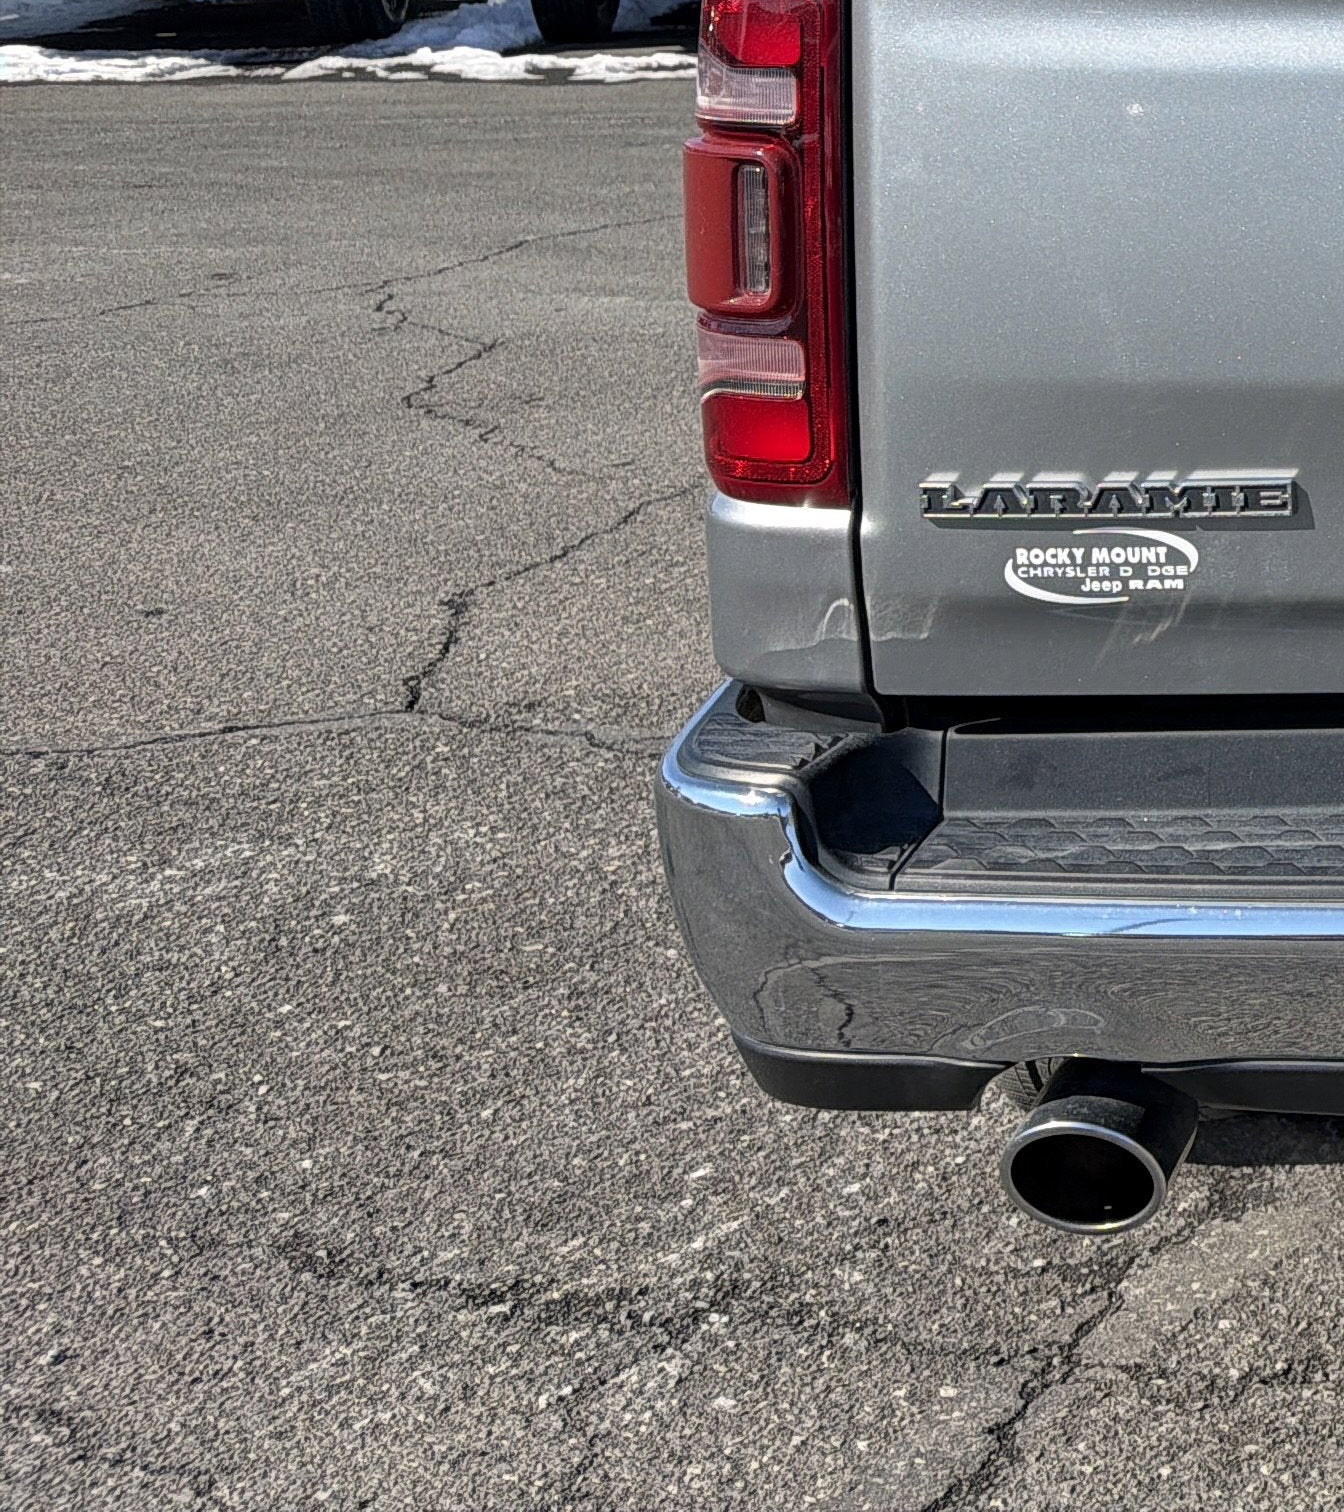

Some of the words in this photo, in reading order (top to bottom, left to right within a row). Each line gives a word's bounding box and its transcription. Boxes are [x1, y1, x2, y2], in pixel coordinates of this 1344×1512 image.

[918, 472, 1298, 518] LARAMIE
[1015, 547, 1085, 565] ROCKY
[1091, 546, 1168, 564] MOUNT
[1017, 566, 1111, 578] CHRYSLER
[1119, 565, 1189, 577] DDGE
[1080, 577, 1123, 593] Jeep
[1128, 578, 1184, 590] RAM
